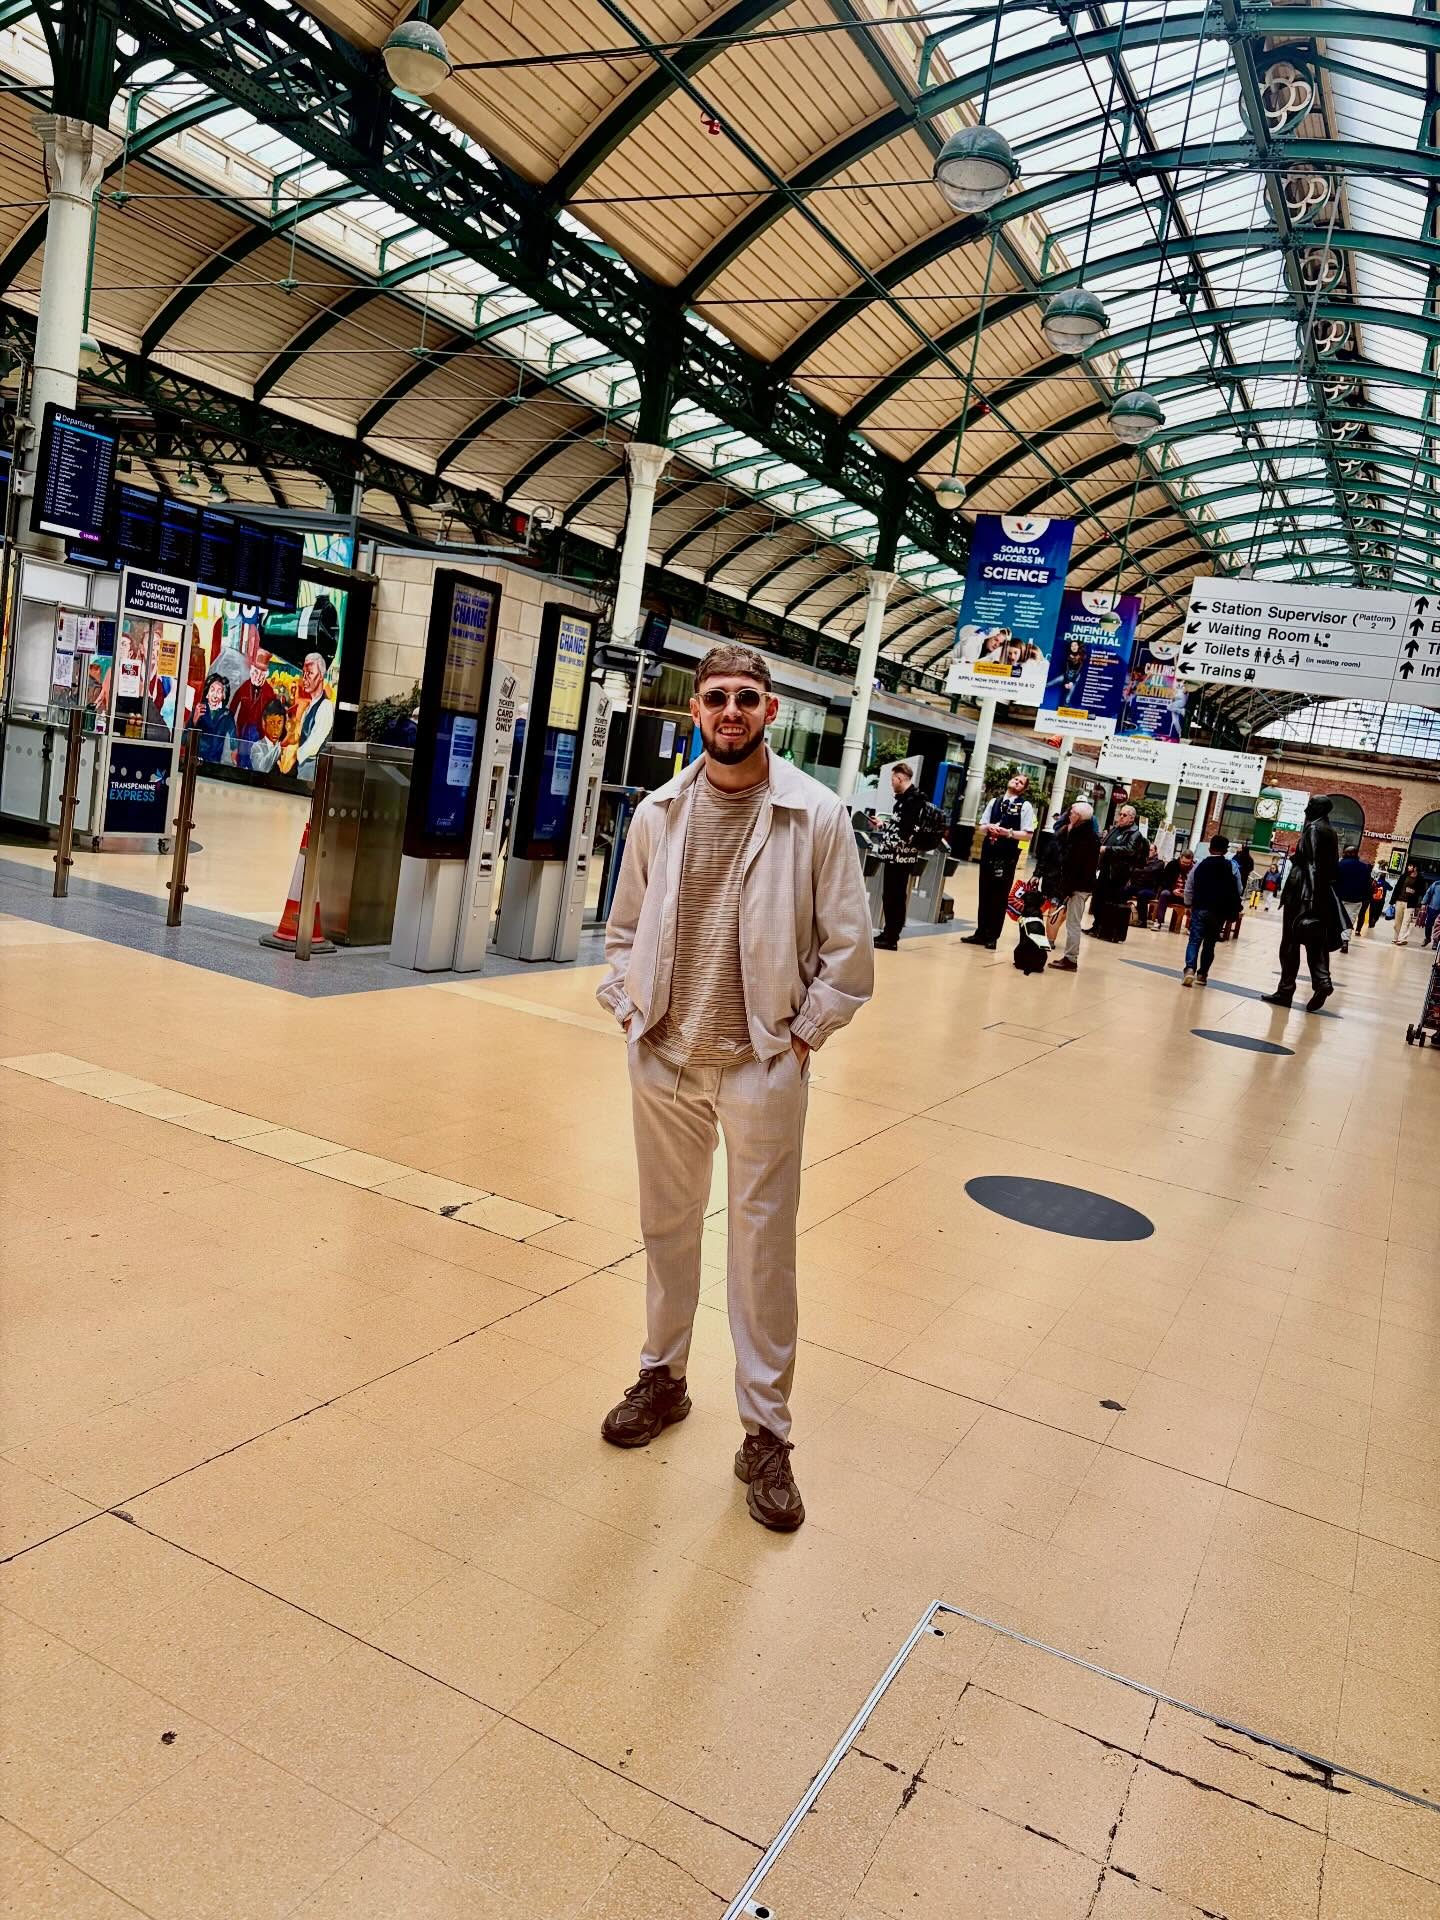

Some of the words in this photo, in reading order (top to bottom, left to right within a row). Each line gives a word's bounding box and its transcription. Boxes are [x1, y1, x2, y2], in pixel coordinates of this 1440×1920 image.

[62, 414, 95, 430] Departures
[1000, 545, 1025, 554] SOAR
[1027, 547, 1040, 555] TO
[992, 553, 1033, 564] SUCCESS
[1034, 556, 1045, 565] IN
[983, 566, 1049, 584] SCIENCE
[141, 581, 175, 594] CUSTOMER
[135, 589, 179, 604] INFORMATION
[130, 598, 144, 606] AND
[145, 601, 183, 614] ASSISTANCE
[454, 603, 488, 629] CHANGE
[1212, 602, 1262, 617] Station
[1268, 606, 1347, 625] Supervisor
[1208, 622, 1261, 640] Waiting
[1268, 628, 1310, 643] Room
[560, 633, 586, 655] CHANGE
[1064, 633, 1121, 647] POTENTIAL
[1204, 642, 1250, 658] Toilets
[1144, 662, 1175, 676] CALLING
[1200, 663, 1242, 678] Trains
[498, 699, 514, 708] TICKETS
[497, 709, 513, 719] CARD
[495, 723, 512, 732] ONLY
[594, 726, 606, 735] CARD
[592, 738, 605, 747] ONLY
[1112, 736, 1127, 744] Cycle
[1187, 771, 1220, 781] Information
[111, 782, 156, 790] TRANSPENNINE
[1213, 783, 1238, 791] Coaches
[110, 790, 155, 801] EXPRESS
